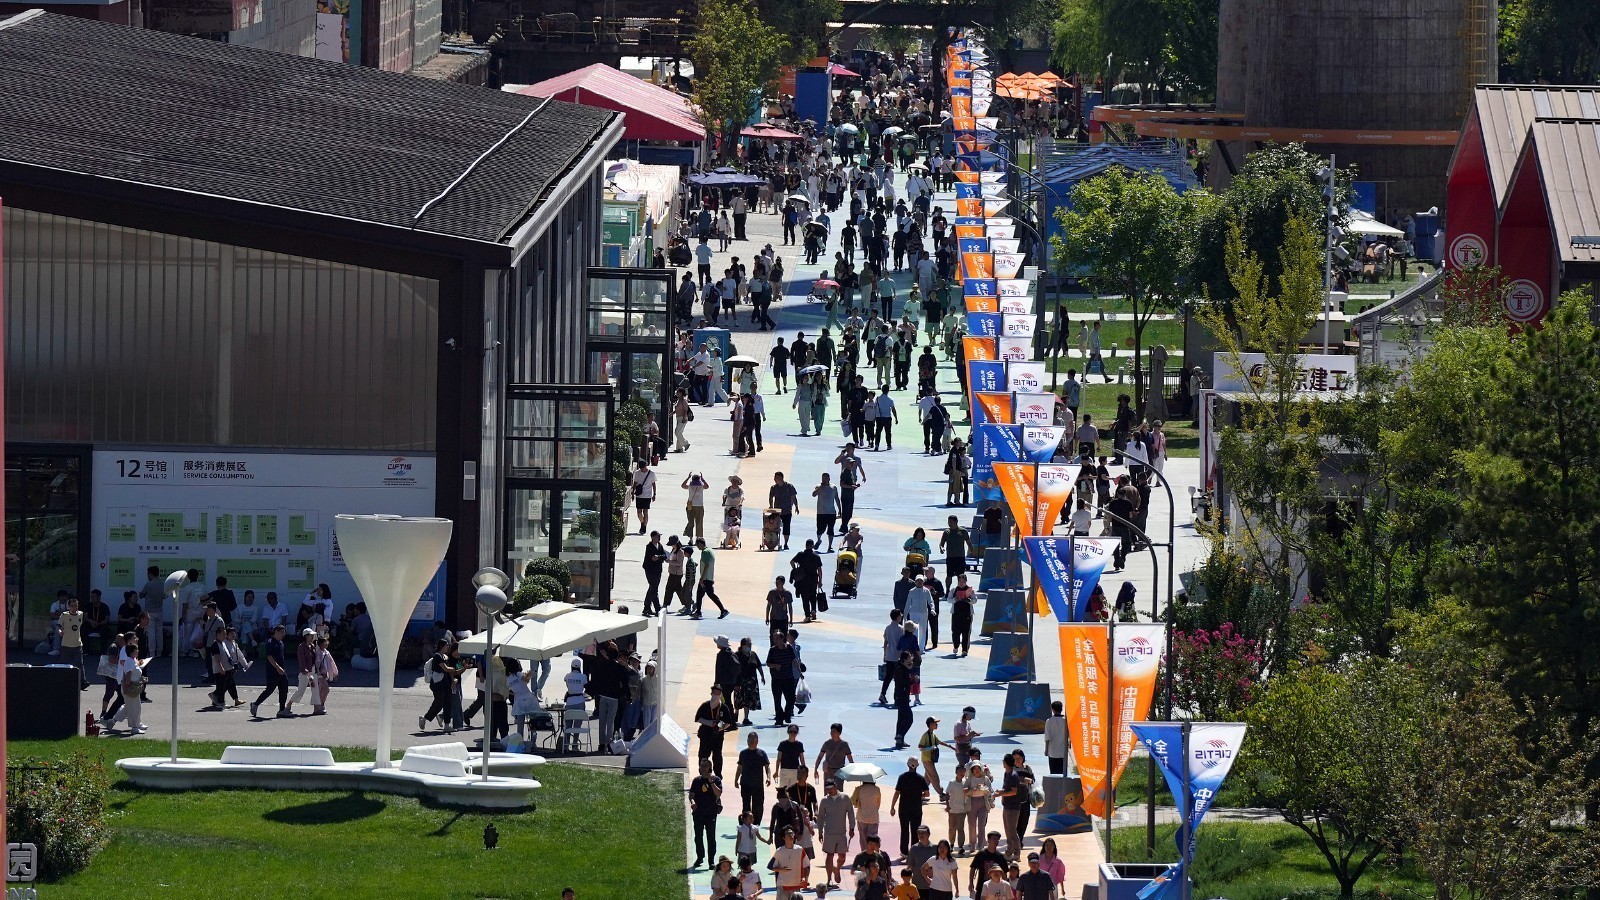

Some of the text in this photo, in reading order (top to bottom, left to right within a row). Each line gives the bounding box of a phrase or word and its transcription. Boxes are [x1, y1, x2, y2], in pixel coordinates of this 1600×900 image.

[1271, 367, 1347, 392] 京建工
[116, 459, 168, 478] 12 号馆
[183, 460, 247, 472] 服务消费展区
